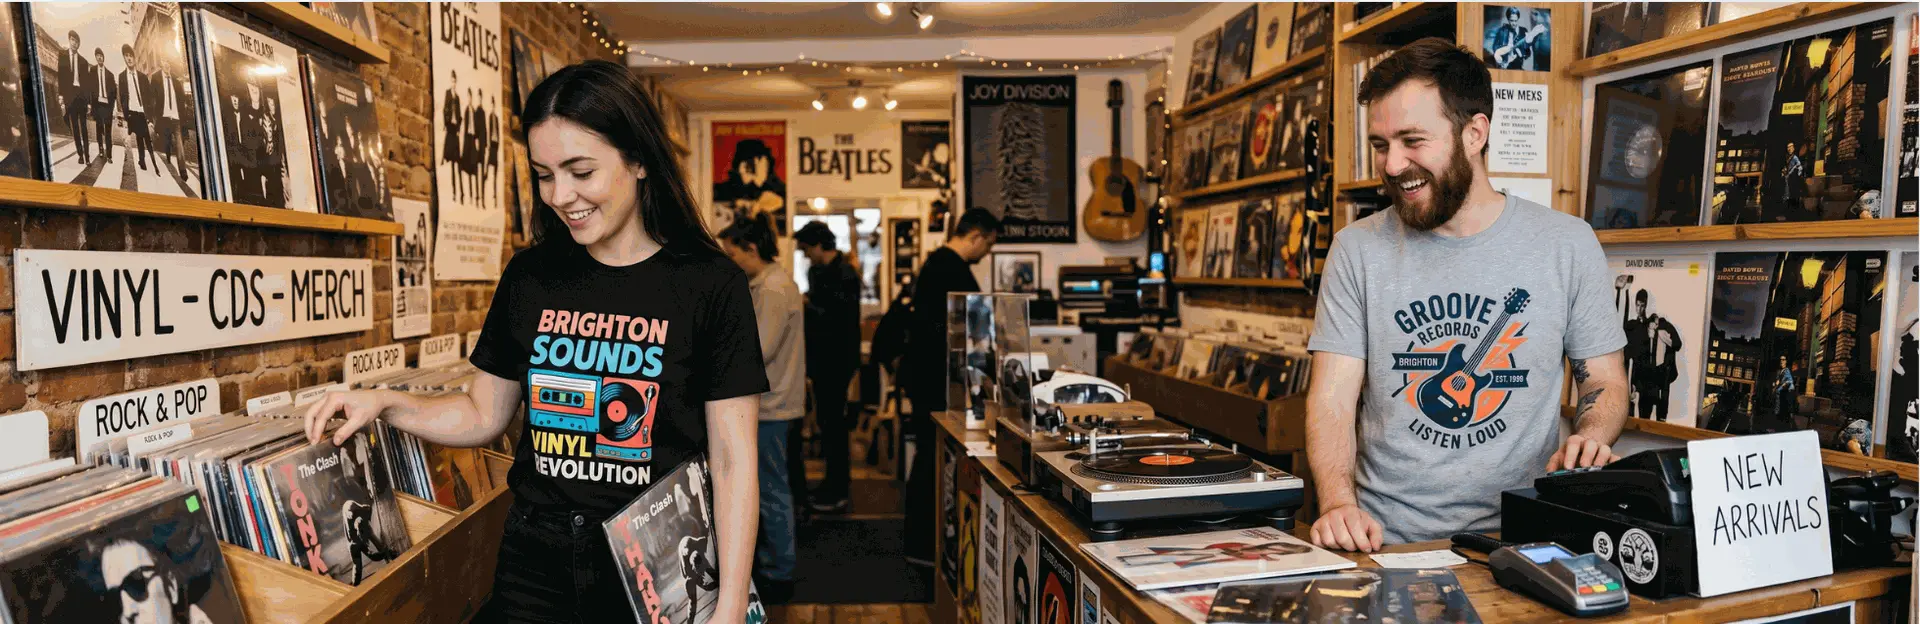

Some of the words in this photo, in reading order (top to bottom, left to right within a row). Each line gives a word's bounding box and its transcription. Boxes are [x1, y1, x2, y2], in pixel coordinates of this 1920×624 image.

[238, 32, 252, 51] THE
[253, 38, 274, 62] CLASH
[440, 2, 499, 71] BEATLES
[969, 84, 1000, 99] JOY
[1003, 84, 1071, 99] DIVISION
[1495, 88, 1514, 100] NEW
[1517, 89, 1543, 101] MEXS
[834, 133, 854, 145] THE
[798, 137, 893, 181] BEATLES
[1625, 259, 1643, 268] DAVID
[1644, 259, 1665, 268] BOWIE
[41, 268, 174, 344] VINYL
[208, 268, 266, 329] CDS
[291, 268, 366, 323] MERCH
[1393, 292, 1497, 335] GROOVE
[536, 309, 669, 345] BRIGHTON
[1417, 322, 1481, 346] RECORDS
[352, 351, 375, 375] ROCK
[376, 352, 383, 369] &
[384, 348, 400, 367] POP
[529, 335, 664, 377] SOUNDS
[1398, 357, 1439, 367] BRIGHTON
[1495, 375, 1508, 383] EST.
[95, 392, 150, 437] ROCK
[156, 393, 169, 423] &
[174, 384, 208, 417] POP
[143, 434, 158, 443] ROCK
[163, 429, 174, 438] POP
[531, 429, 592, 458] VINYL
[1408, 418, 1461, 449] LISTEN
[1467, 418, 1507, 448] LOUD
[298, 461, 316, 479] The
[316, 453, 339, 473] Clash
[1722, 449, 1784, 493] NEW
[632, 512, 650, 530] The
[649, 492, 674, 517] Clash
[1712, 495, 1823, 546] ARRIVALS
